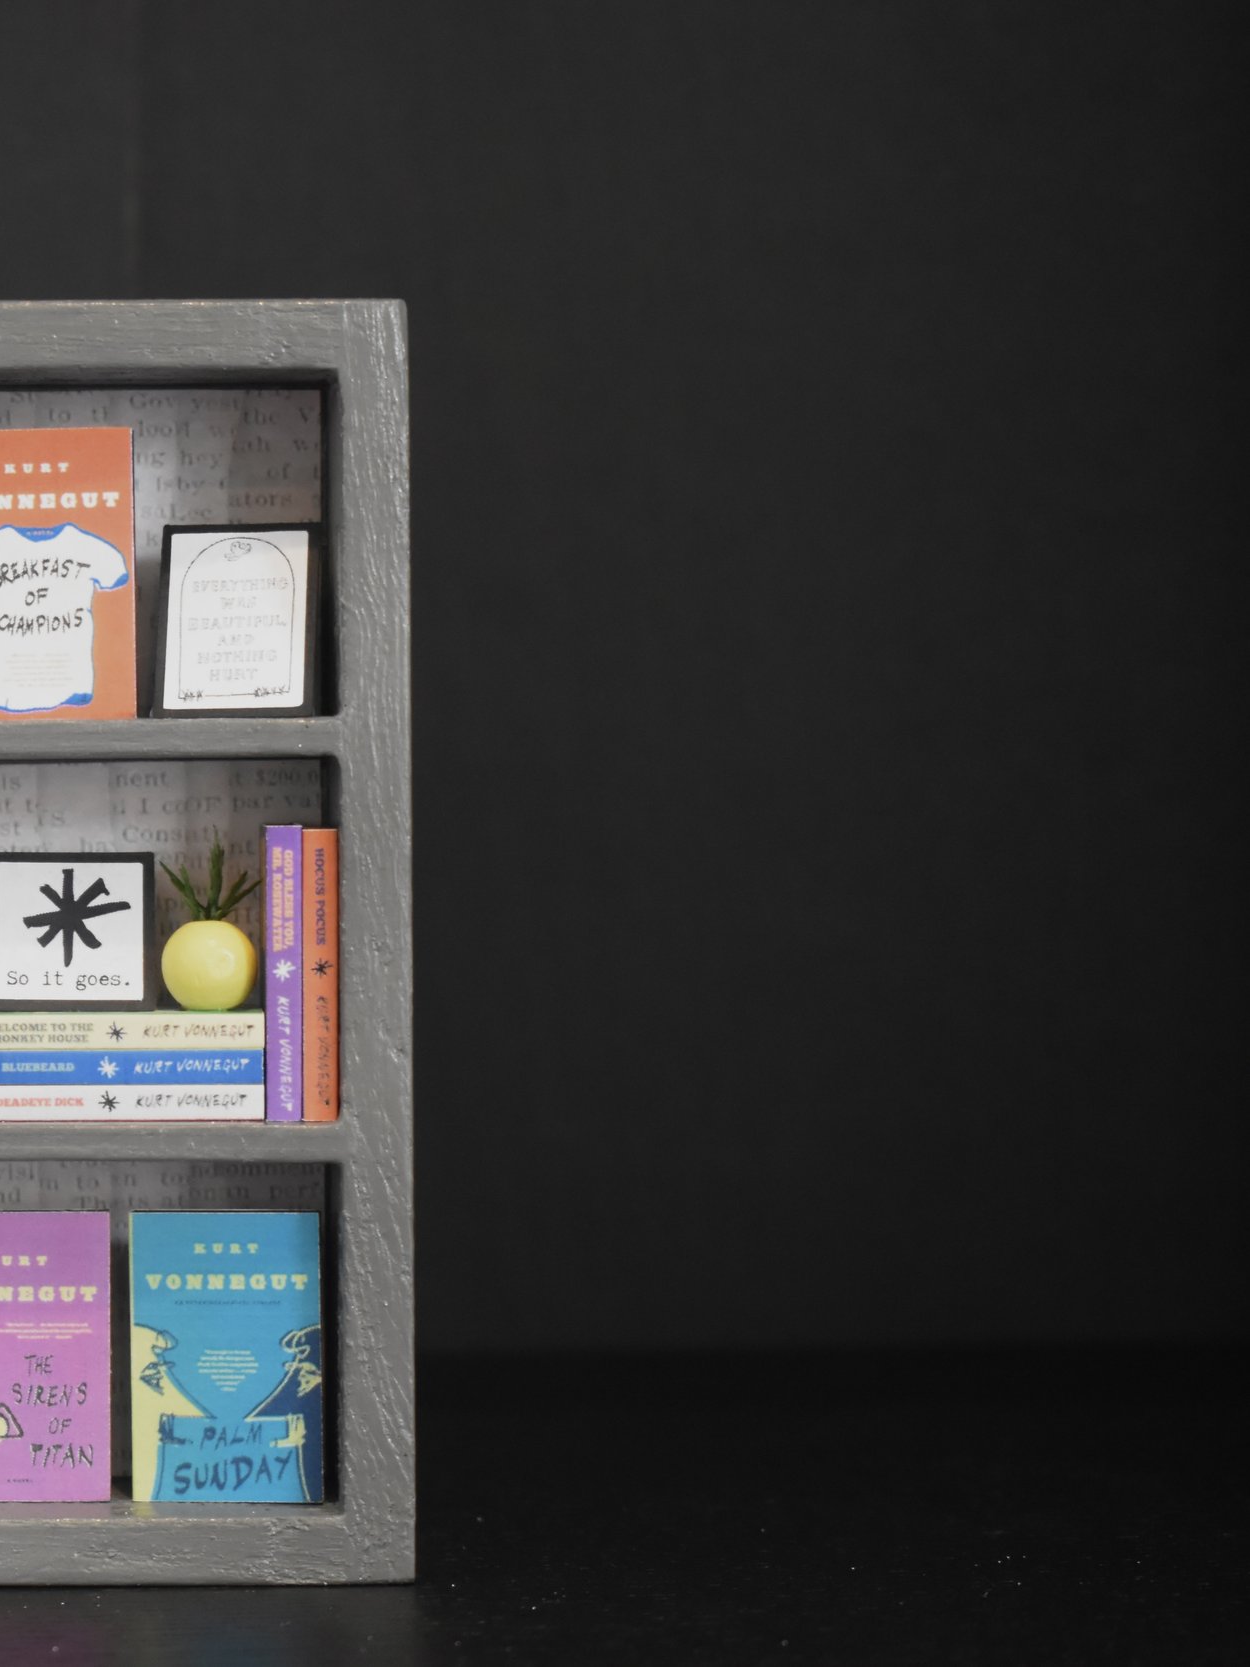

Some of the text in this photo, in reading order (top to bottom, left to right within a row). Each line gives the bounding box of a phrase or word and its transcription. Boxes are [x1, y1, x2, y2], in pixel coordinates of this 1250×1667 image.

[4, 462, 71, 474] KURT
[192, 577, 289, 593] EVERYTHING
[24, 588, 49, 607] OF
[220, 596, 257, 609] WAS
[188, 614, 287, 631] BEAUTIFUL
[217, 634, 254, 647] AND
[198, 649, 277, 665] NOTHING
[209, 668, 258, 682] HURT
[283, 849, 294, 877] GOD
[283, 878, 294, 919] BLESS
[314, 848, 327, 946] HOCUS POCUS
[272, 873, 283, 953] ROSEWATER
[6, 970, 132, 991] So it goes.
[48, 1022, 67, 1032] TO
[70, 1022, 94, 1032] THE
[141, 1022, 255, 1039] KURT VONNEGUT
[47, 1034, 90, 1044] HOUSE
[276, 995, 294, 1112] KURT VONNEGUT
[1, 1062, 76, 1073] BLUEBEARD
[133, 1057, 251, 1074] KURT VONNEGUT
[317, 1037, 330, 1106] VONNEGUT
[54, 1096, 85, 1108] DICK
[135, 1093, 248, 1109] KURT VONNEGUT
[193, 1242, 259, 1254] KURT
[145, 1273, 309, 1290] VONNEGUT
[24, 1354, 54, 1376] THE
[12, 1382, 88, 1407] SIRENS
[47, 1416, 73, 1435] OF
[200, 1420, 264, 1446] PALM
[30, 1443, 95, 1469] TITAN
[173, 1450, 293, 1494] SUNDAY
